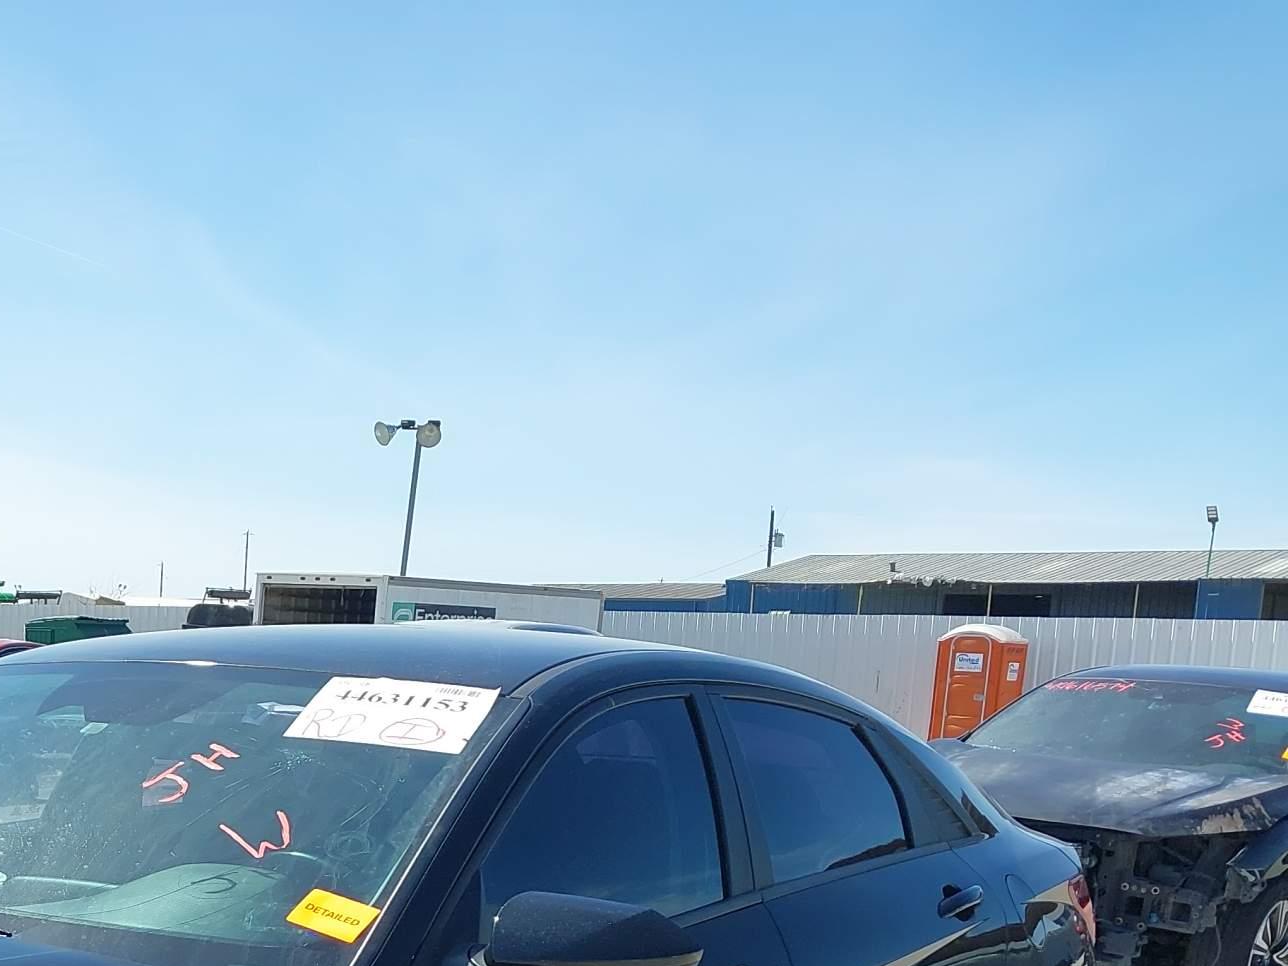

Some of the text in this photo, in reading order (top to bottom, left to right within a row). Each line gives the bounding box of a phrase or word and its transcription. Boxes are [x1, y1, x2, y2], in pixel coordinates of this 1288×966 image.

[415, 608, 495, 621] Enteri
[336, 689, 469, 713] 44631153
[304, 901, 361, 928] DETAILED
